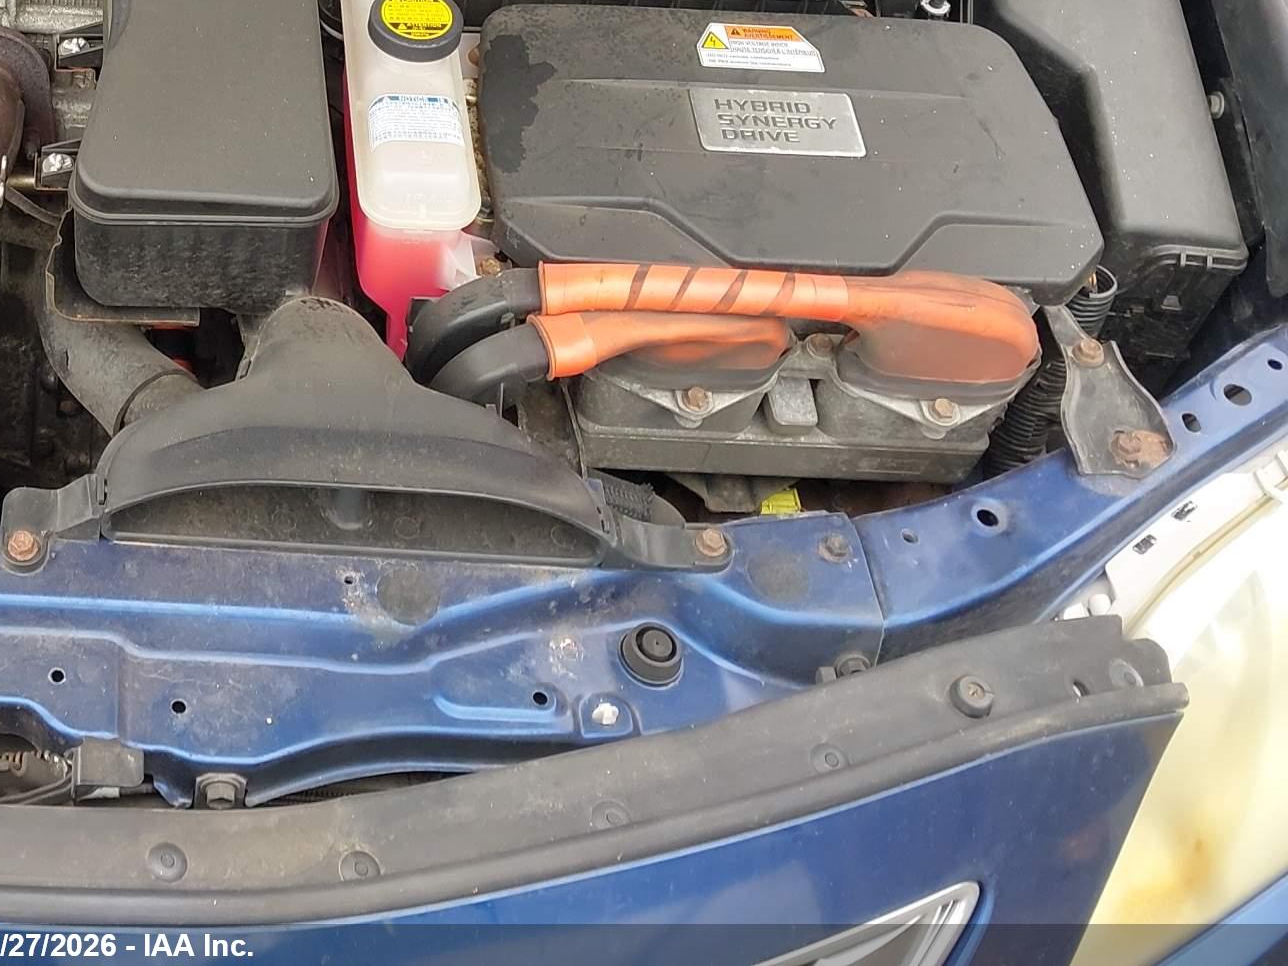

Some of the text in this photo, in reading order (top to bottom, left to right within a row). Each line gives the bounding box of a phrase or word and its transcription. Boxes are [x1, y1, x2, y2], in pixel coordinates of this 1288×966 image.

[714, 98, 811, 114] HYBRID
[717, 113, 837, 130] SYNERGY
[720, 128, 800, 143] DRIVE
